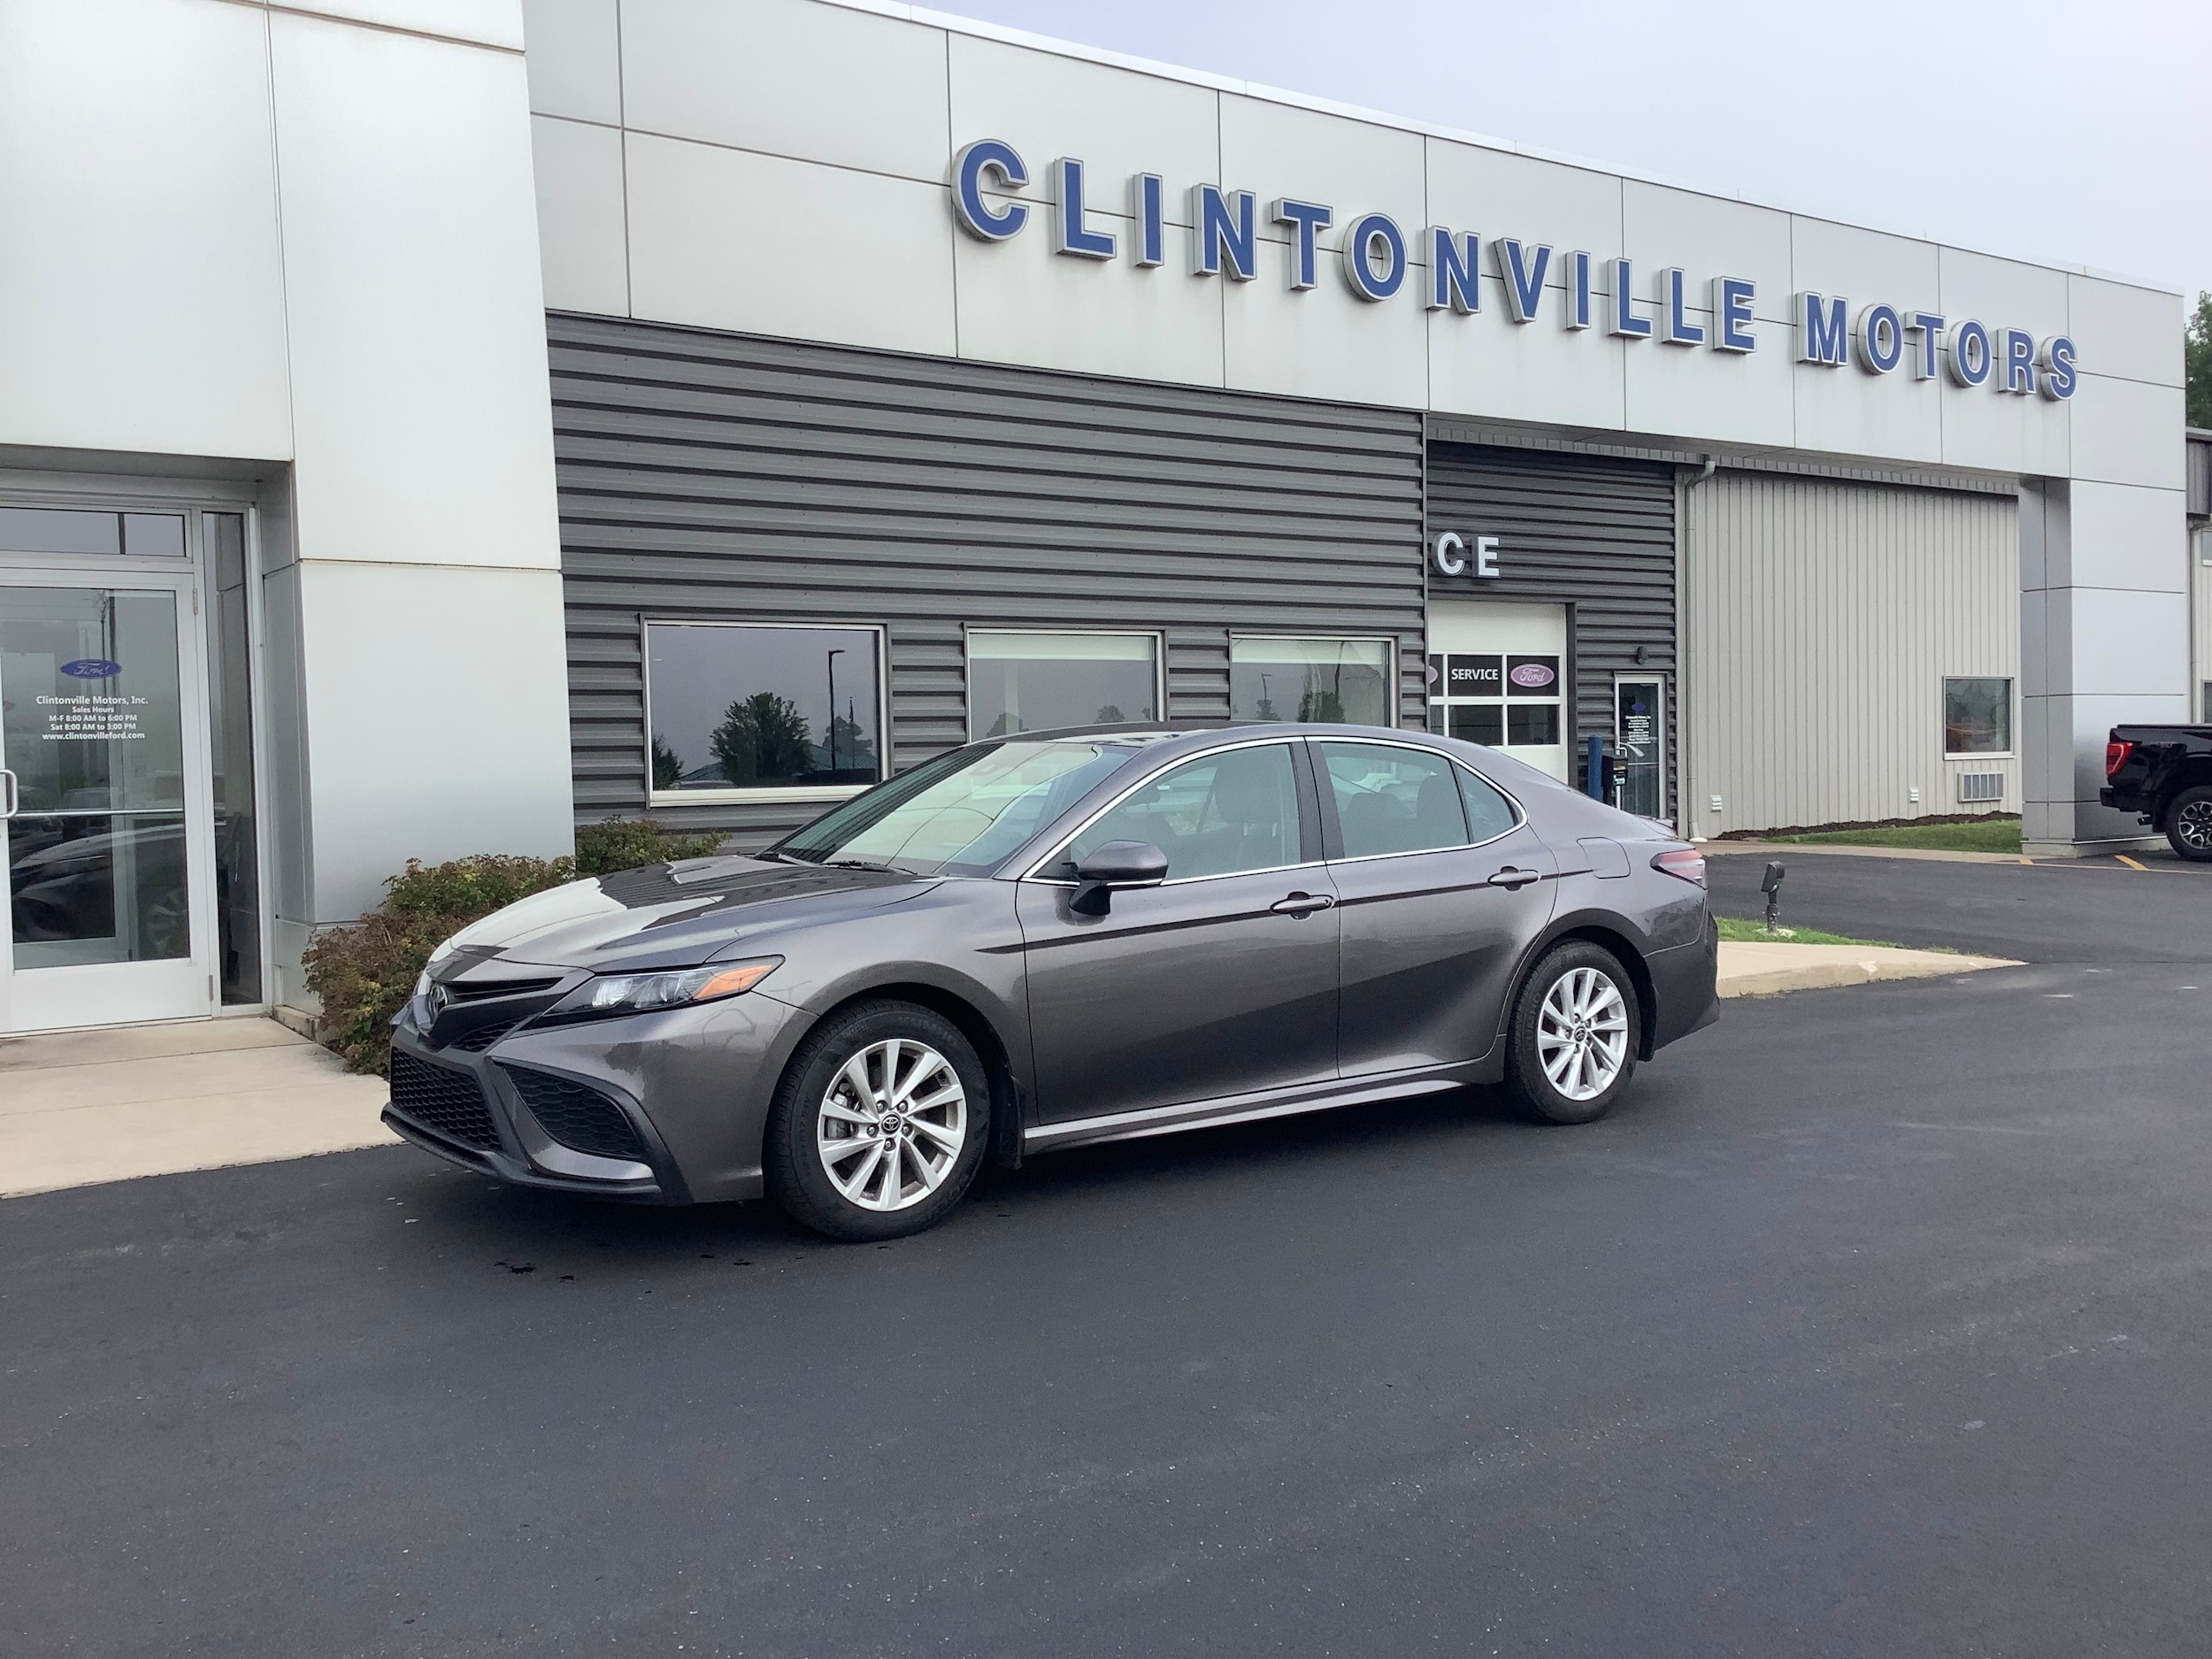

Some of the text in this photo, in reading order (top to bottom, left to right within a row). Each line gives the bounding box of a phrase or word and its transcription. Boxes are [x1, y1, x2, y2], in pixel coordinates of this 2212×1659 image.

[951, 138, 2078, 402] CLINTONVILLE MOTORS
[1451, 668, 1499, 680] SERVICE
[35, 695, 149, 705] Clintonville Motors, Inc.
